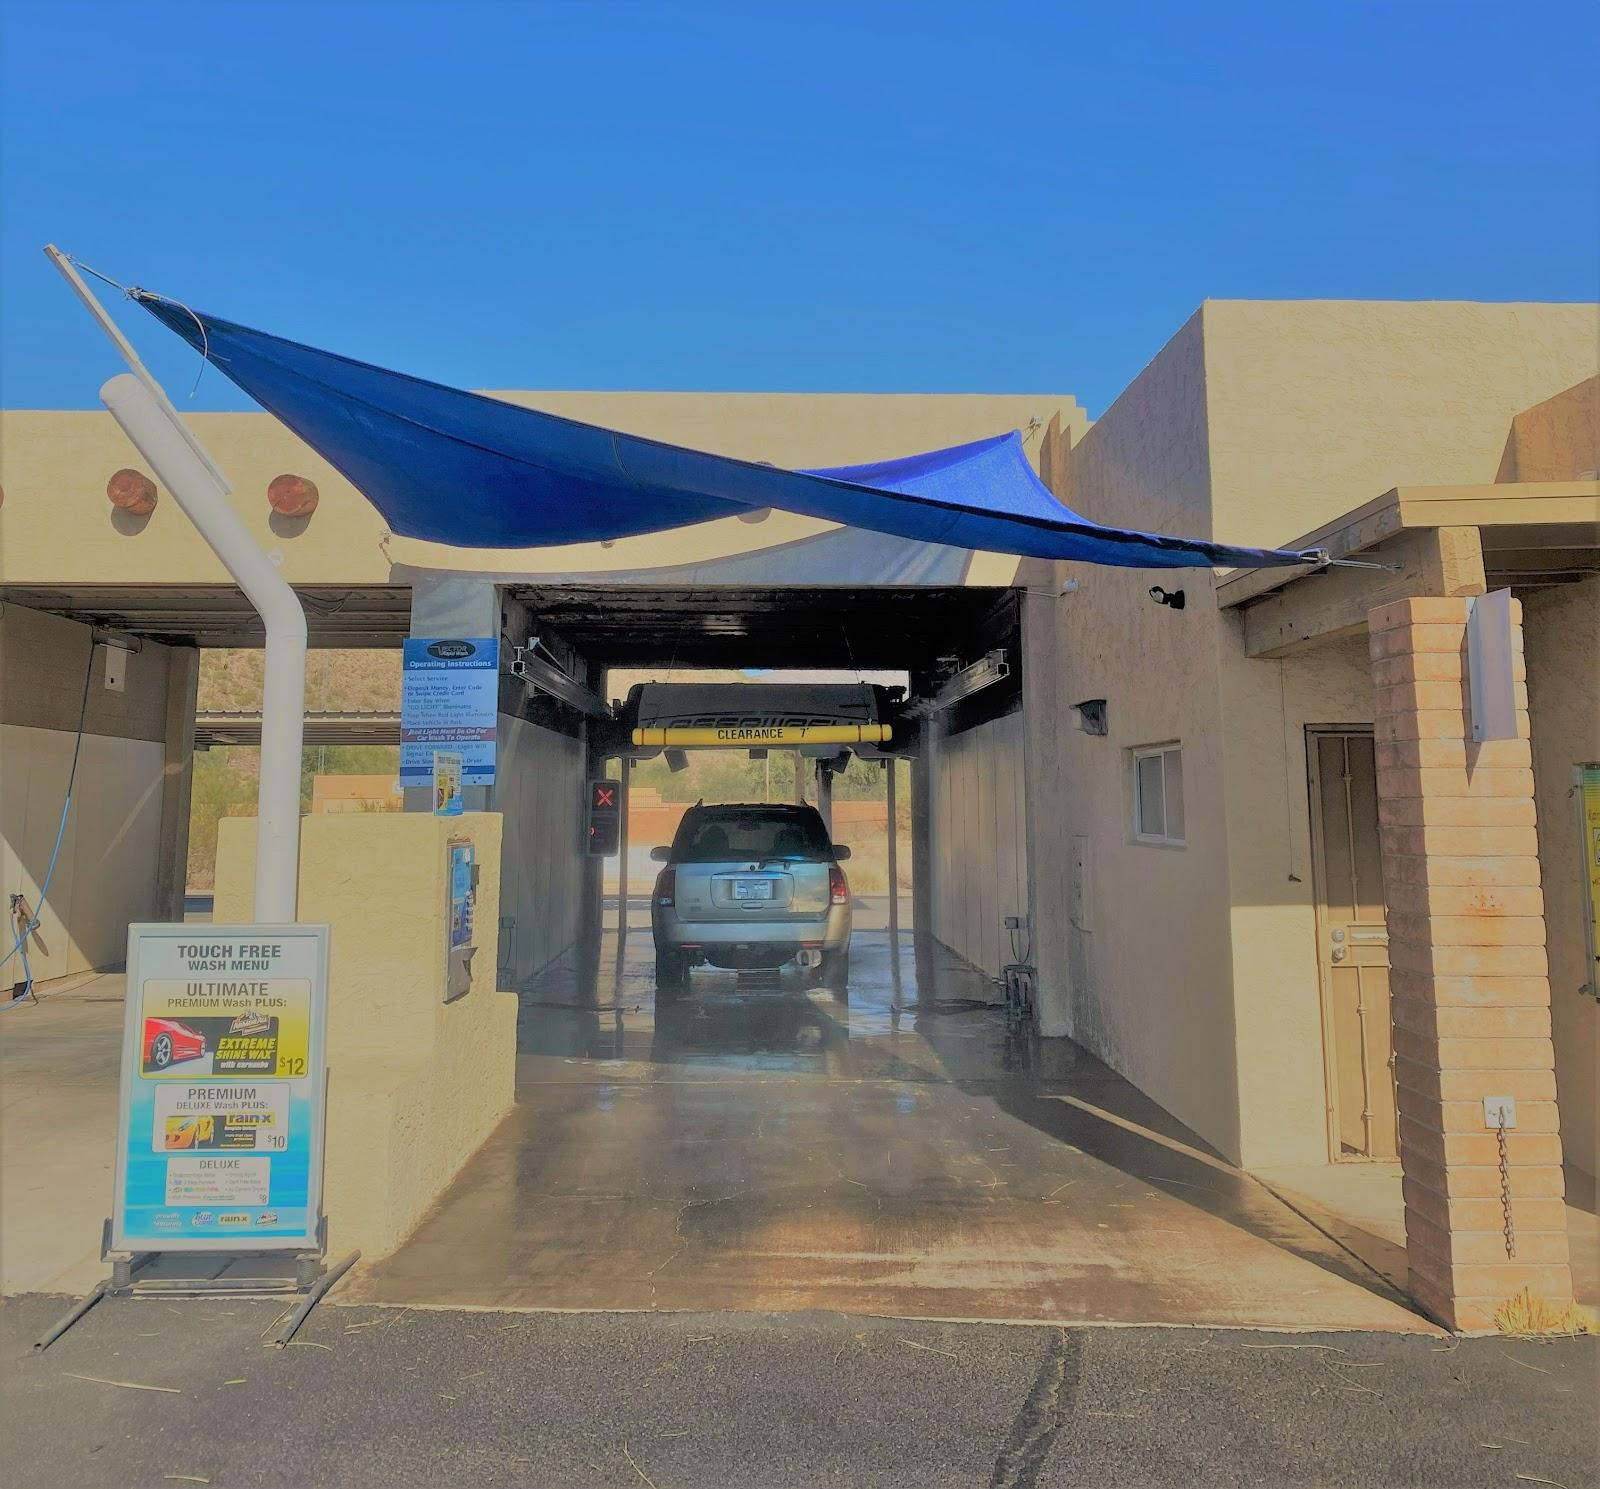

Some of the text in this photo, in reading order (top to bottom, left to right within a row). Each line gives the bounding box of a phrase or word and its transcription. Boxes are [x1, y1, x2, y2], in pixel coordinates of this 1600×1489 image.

[410, 659, 492, 669] Operating Instructions
[717, 728, 784, 740] CLEARANCE
[177, 945, 281, 958] TOUCH FREE
[188, 960, 270, 971] WASH MENU
[186, 982, 270, 996] ULTIMATE
[167, 998, 287, 1008] PREMIUM Wash PLUS:
[218, 1038, 277, 1050] EXTREME
[215, 1049, 272, 1060] SHINE WAX
[279, 1056, 305, 1075] $12
[188, 1088, 257, 1100] PREMIUM
[176, 1101, 269, 1110] DELUXE Wash PLUS:
[267, 1135, 285, 1148] $10
[199, 1159, 241, 1169] DELUXE
